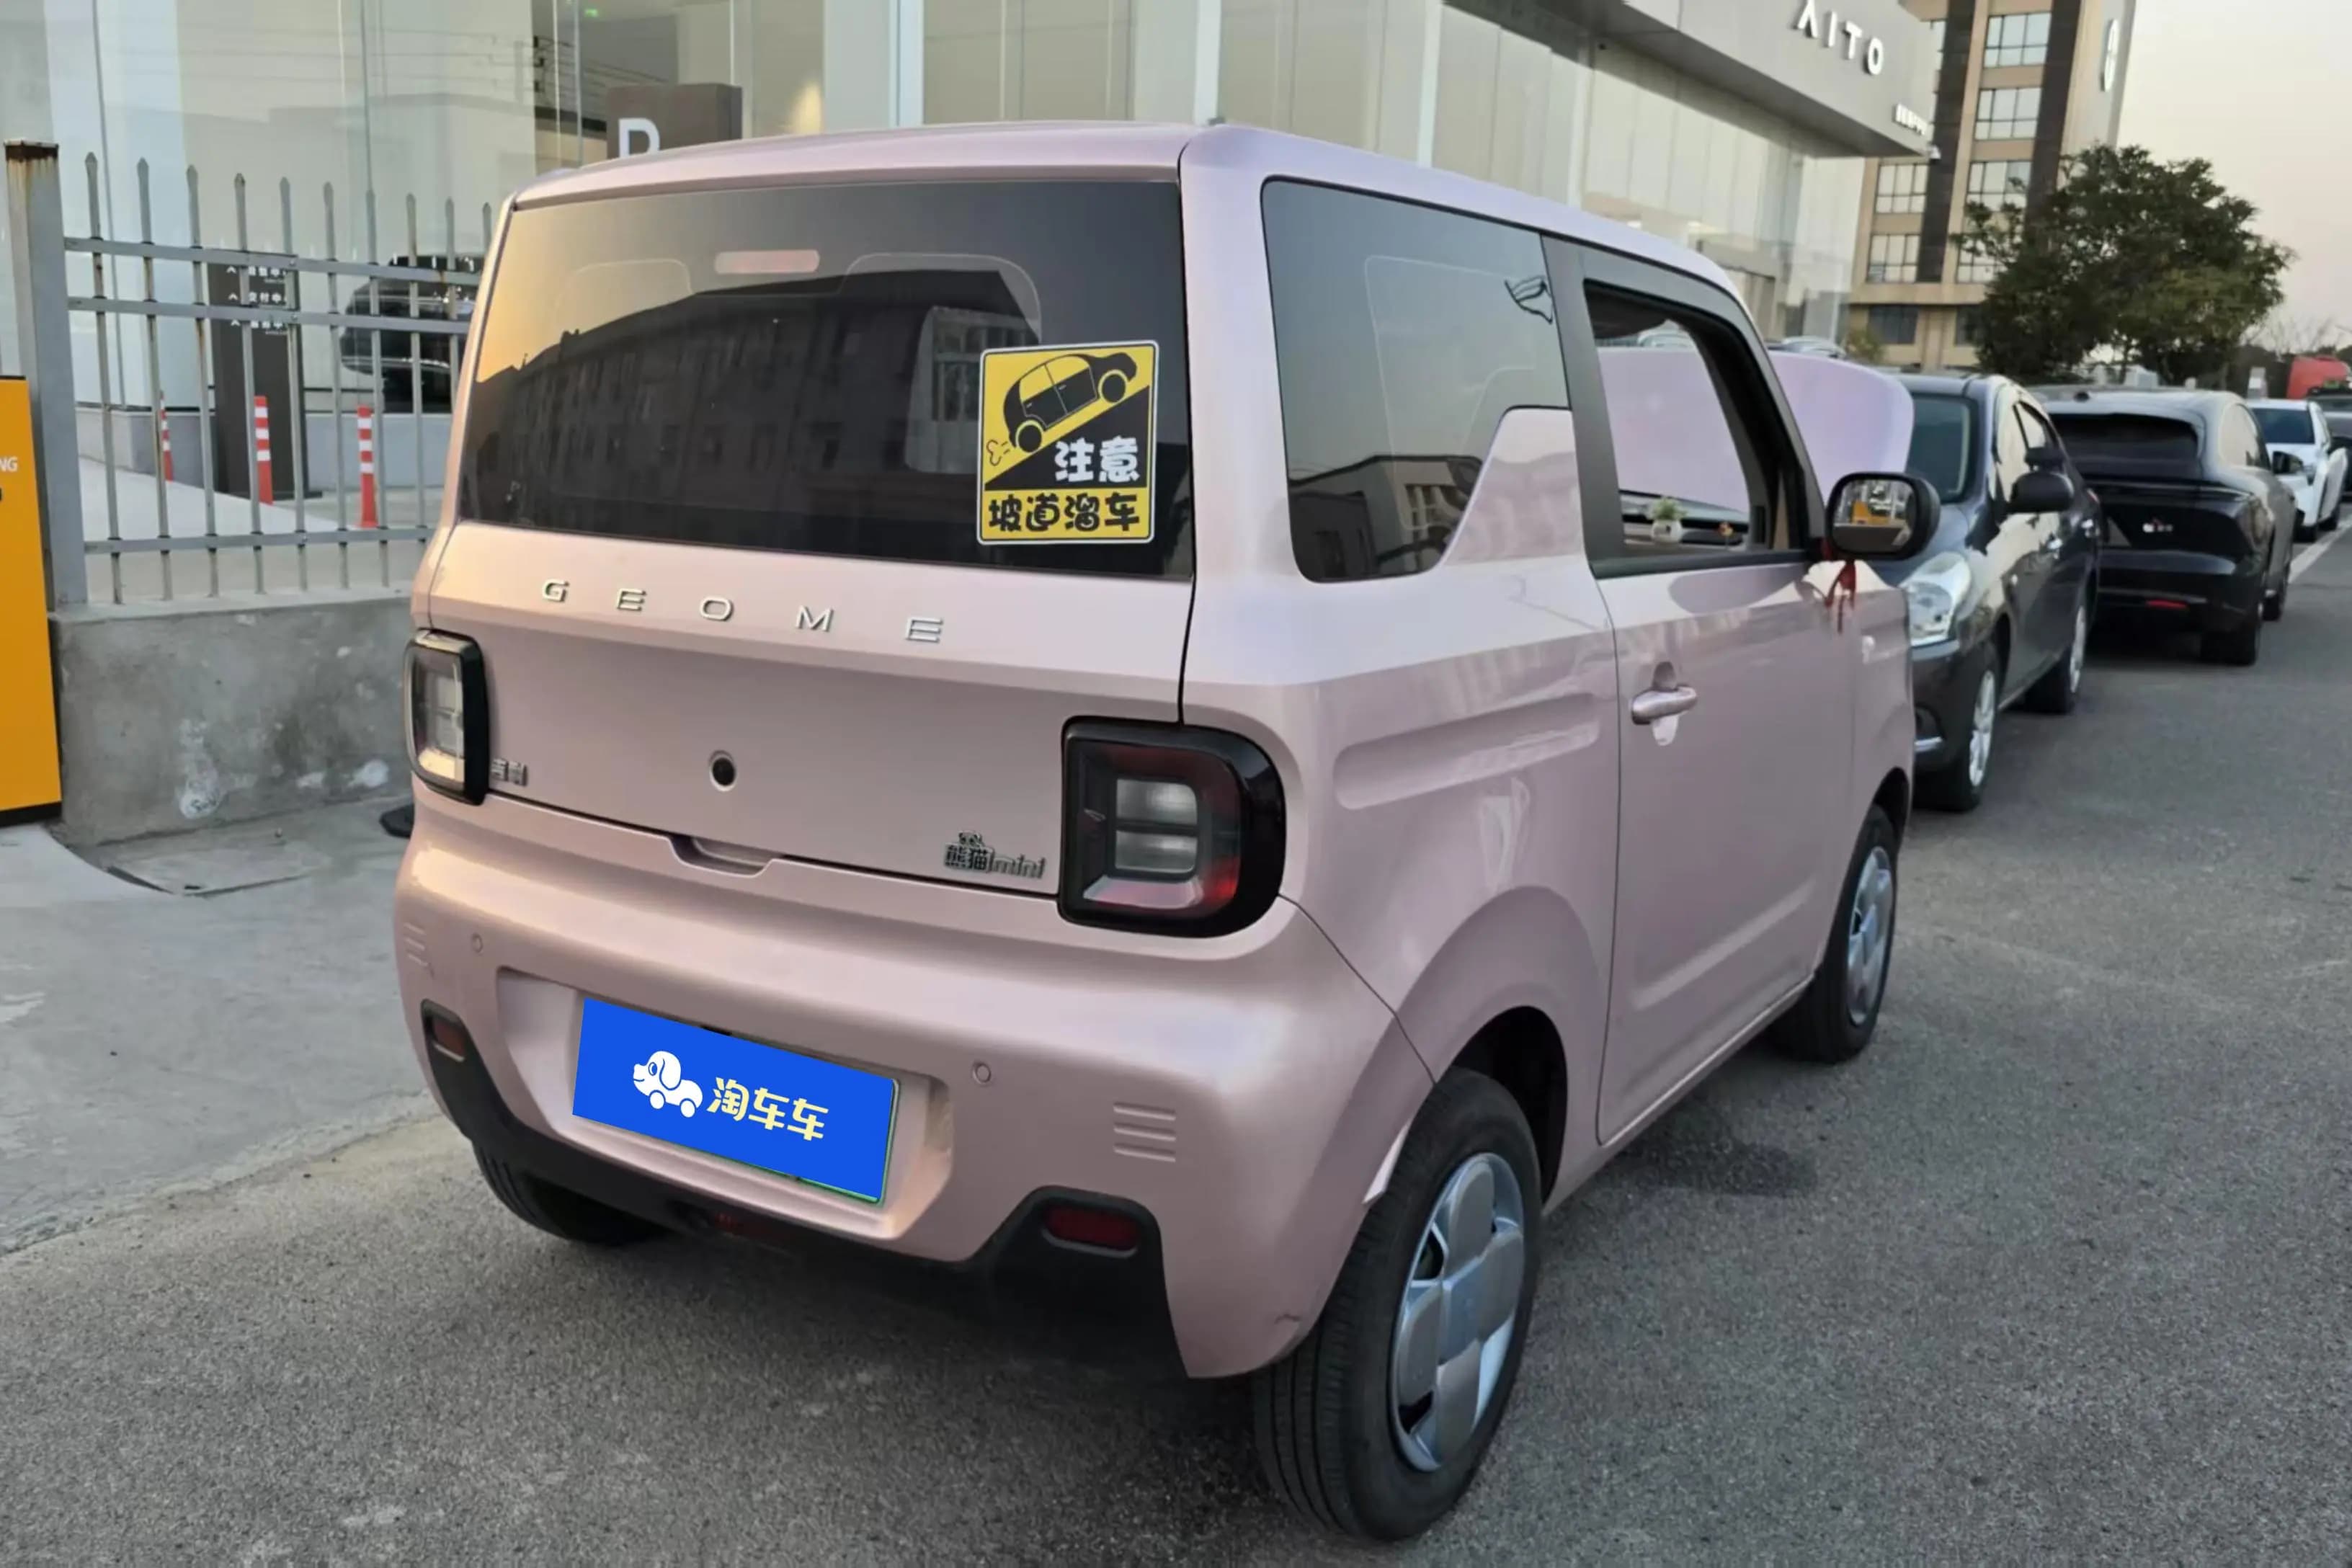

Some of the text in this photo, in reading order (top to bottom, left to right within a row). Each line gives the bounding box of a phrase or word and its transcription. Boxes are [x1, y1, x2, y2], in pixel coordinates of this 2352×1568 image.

[1797, 0, 1884, 75] AITO
[1054, 435, 1140, 482] 注意
[989, 492, 1139, 532] 坡道溜车
[541, 579, 943, 643] GEOME
